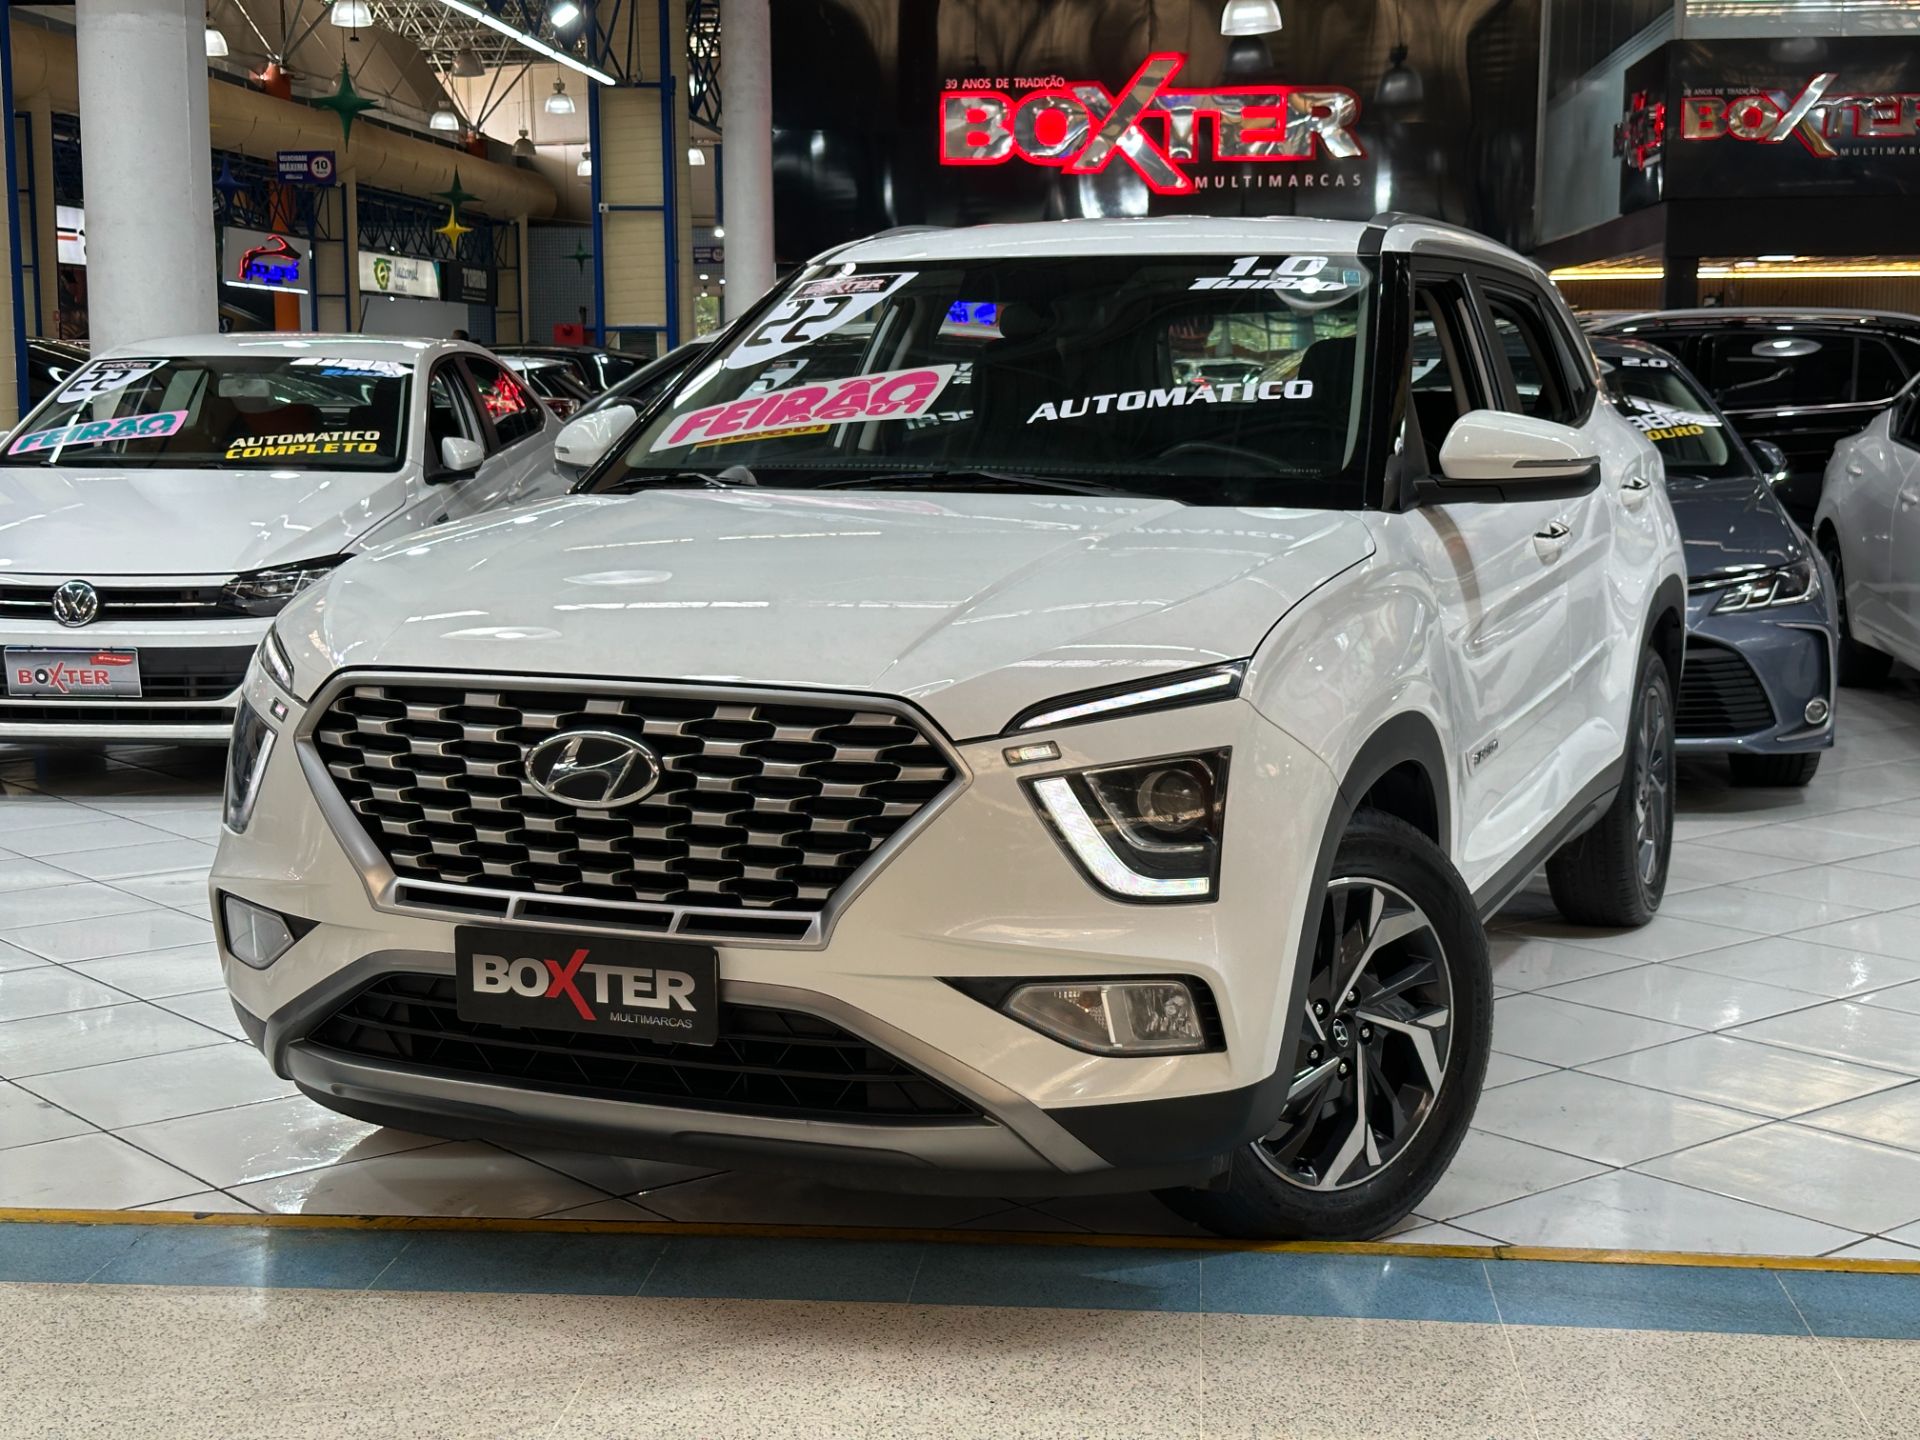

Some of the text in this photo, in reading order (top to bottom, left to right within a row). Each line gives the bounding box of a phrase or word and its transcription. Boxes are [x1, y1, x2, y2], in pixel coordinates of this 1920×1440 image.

[945, 74, 1065, 89] 39 ANOS DE TRADIÇÃO
[939, 52, 1368, 195] BOXTER
[1840, 145, 1920, 156] MULTIMAR
[314, 160, 329, 170] 10
[1195, 173, 1362, 189] MULTIMARCAS
[1228, 256, 1329, 277] 1.0
[744, 296, 853, 348] 22
[1622, 357, 1668, 368] 2.0
[67, 369, 131, 393] 22
[668, 370, 940, 445] FEIRÃO
[229, 431, 380, 448] AUTOMATICO
[225, 443, 378, 459] COMPLETO
[17, 661, 112, 694] BOXTER
[472, 949, 697, 1021] BOXTER
[609, 1012, 693, 1029] MULTIMARCAS
